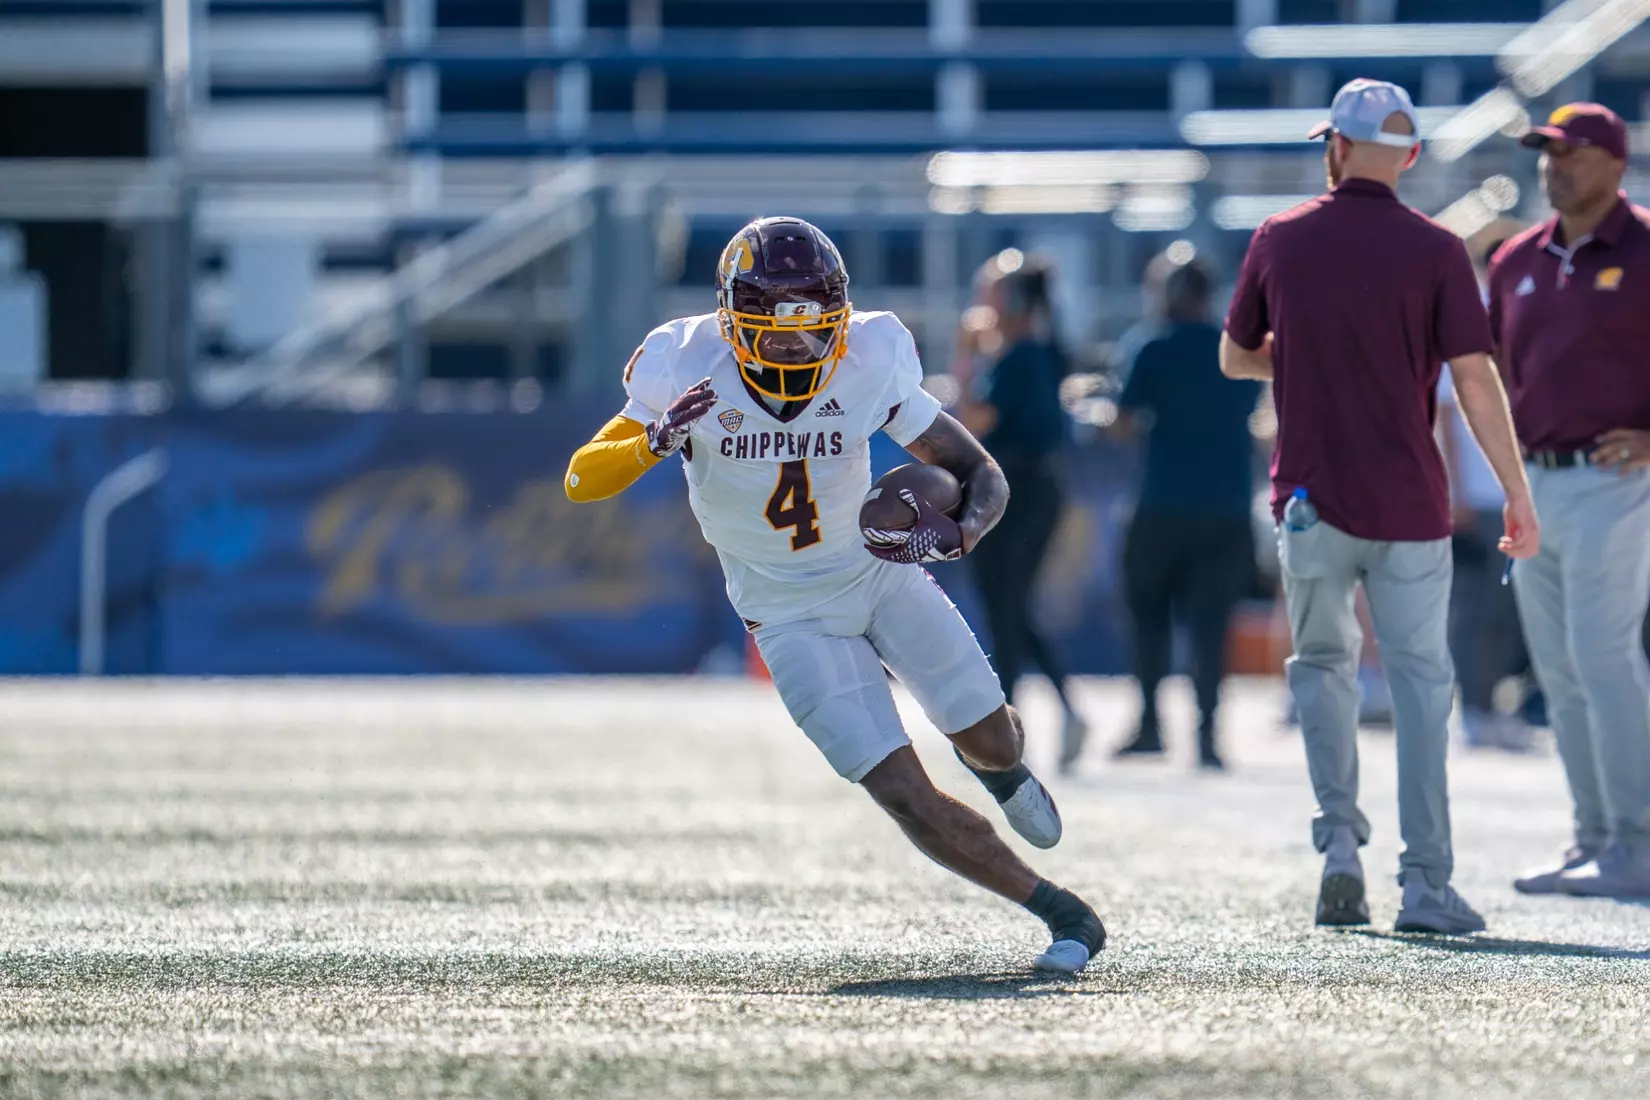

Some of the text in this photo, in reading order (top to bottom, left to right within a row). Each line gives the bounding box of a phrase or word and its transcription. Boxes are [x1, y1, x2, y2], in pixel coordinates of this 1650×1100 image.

[815, 409, 845, 418] adidas
[720, 431, 842, 459] CHIPPEWAS
[764, 457, 822, 552] 4
